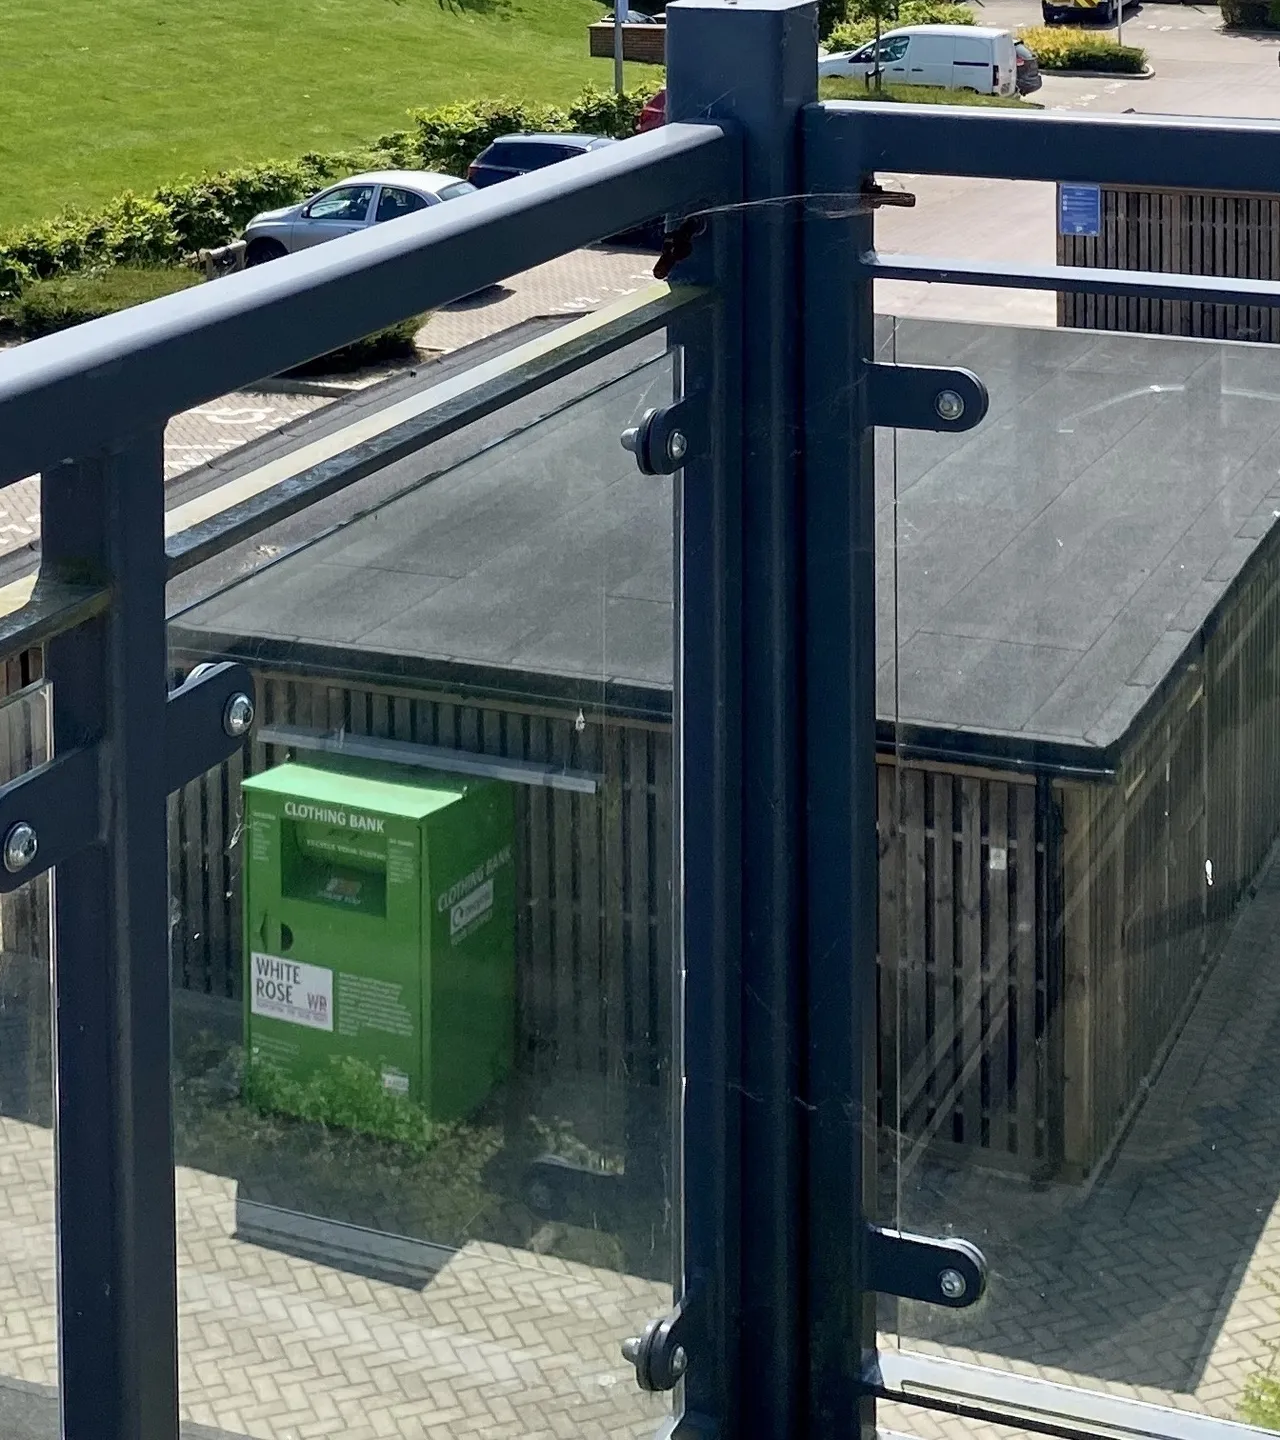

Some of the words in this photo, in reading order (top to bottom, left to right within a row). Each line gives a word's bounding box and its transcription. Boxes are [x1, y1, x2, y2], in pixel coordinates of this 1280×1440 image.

[284, 801, 346, 826] CLOTHING
[349, 814, 385, 834] BANK
[438, 864, 484, 912] CLOTHING
[486, 844, 512, 876] BANK
[256, 957, 301, 985] WHITE
[256, 978, 293, 1004] ROSE
